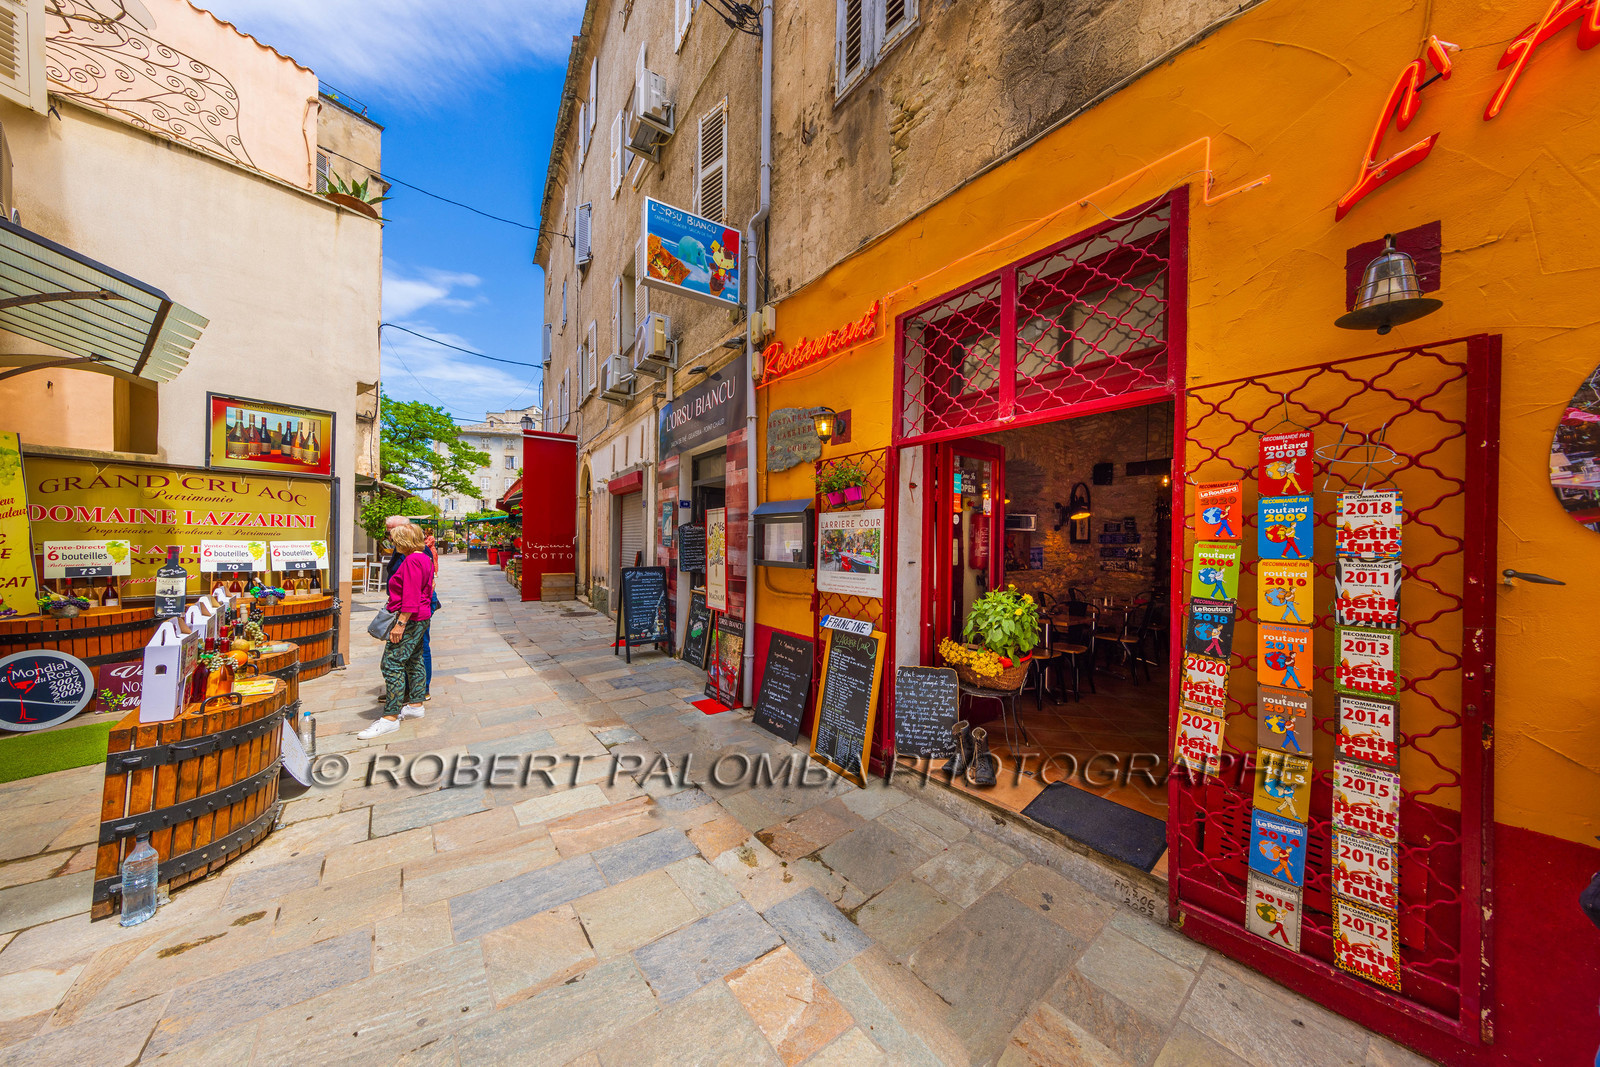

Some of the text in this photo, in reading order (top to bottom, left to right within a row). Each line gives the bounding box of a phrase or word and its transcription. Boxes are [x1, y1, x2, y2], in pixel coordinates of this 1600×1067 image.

[687, 216, 718, 234] BIANCU
[666, 376, 736, 432] L'ORSU BIANCU
[1263, 433, 1299, 442] RECOMMANDÉ
[1264, 441, 1308, 452] routard
[1265, 449, 1306, 460] 2008
[38, 474, 307, 506] GRAND CRU AOC
[141, 489, 234, 504] Patrimonio
[961, 484, 976, 494] OPEN
[1208, 486, 1236, 496] Routard
[1200, 496, 1237, 506] 2020
[1346, 502, 1392, 515] 2018
[28, 504, 316, 528] DOMAINE LAZZARINI
[1264, 506, 1307, 514] routard
[1264, 513, 1306, 522] 2009
[81, 526, 154, 536] Propriétaire
[821, 520, 855, 529] L'ARRIERE
[1338, 526, 1400, 542] petit
[204, 548, 212, 557] 6
[214, 549, 249, 557] bouteilles
[273, 548, 281, 557] 6
[1347, 540, 1400, 553] futé
[48, 550, 108, 560] 6 bouteilles
[1199, 558, 1234, 567] 2006
[1265, 577, 1306, 586] 2010
[1344, 571, 1389, 584] 2011
[1337, 598, 1398, 611] petit
[1194, 612, 1228, 624] 2018
[1345, 608, 1398, 624] futé
[1264, 634, 1307, 644] routard
[1343, 632, 1391, 640] RECOMMANDÉ
[1265, 641, 1304, 652] 2011
[1344, 640, 1389, 656] 2013
[11, 660, 68, 680] Mondial
[1186, 657, 1226, 676] 2020
[34, 666, 79, 684] du Rosé
[48, 675, 80, 689] 2007
[1336, 666, 1398, 683] petit
[50, 681, 82, 695] 2008
[52, 687, 84, 700] 2009
[1183, 681, 1225, 698] petit
[1345, 677, 1398, 696] futé
[1263, 696, 1307, 709] routard
[1342, 699, 1391, 710] RECOMMANDÉ
[1264, 703, 1306, 718] 2012
[1343, 707, 1390, 727] 2014
[1181, 712, 1220, 734] 2021
[1177, 736, 1219, 756] petit
[1336, 733, 1398, 754] petit
[1345, 745, 1398, 766] futé
[1264, 766, 1306, 784] 2013
[1342, 775, 1389, 797] 2015
[1334, 801, 1396, 826] petit
[1258, 820, 1301, 835] Le Routard
[1343, 813, 1395, 838] futé
[1258, 828, 1300, 848] 2014
[1340, 845, 1390, 870] 2016
[1334, 867, 1396, 897] petit
[1262, 885, 1295, 899] Routard
[1343, 880, 1395, 909] futé
[1255, 890, 1295, 912] 2015
[1340, 905, 1389, 925] RECOMMANDÉ
[1342, 913, 1388, 941] 2012
[1336, 939, 1398, 972] petit
[1345, 953, 1398, 984] futé
